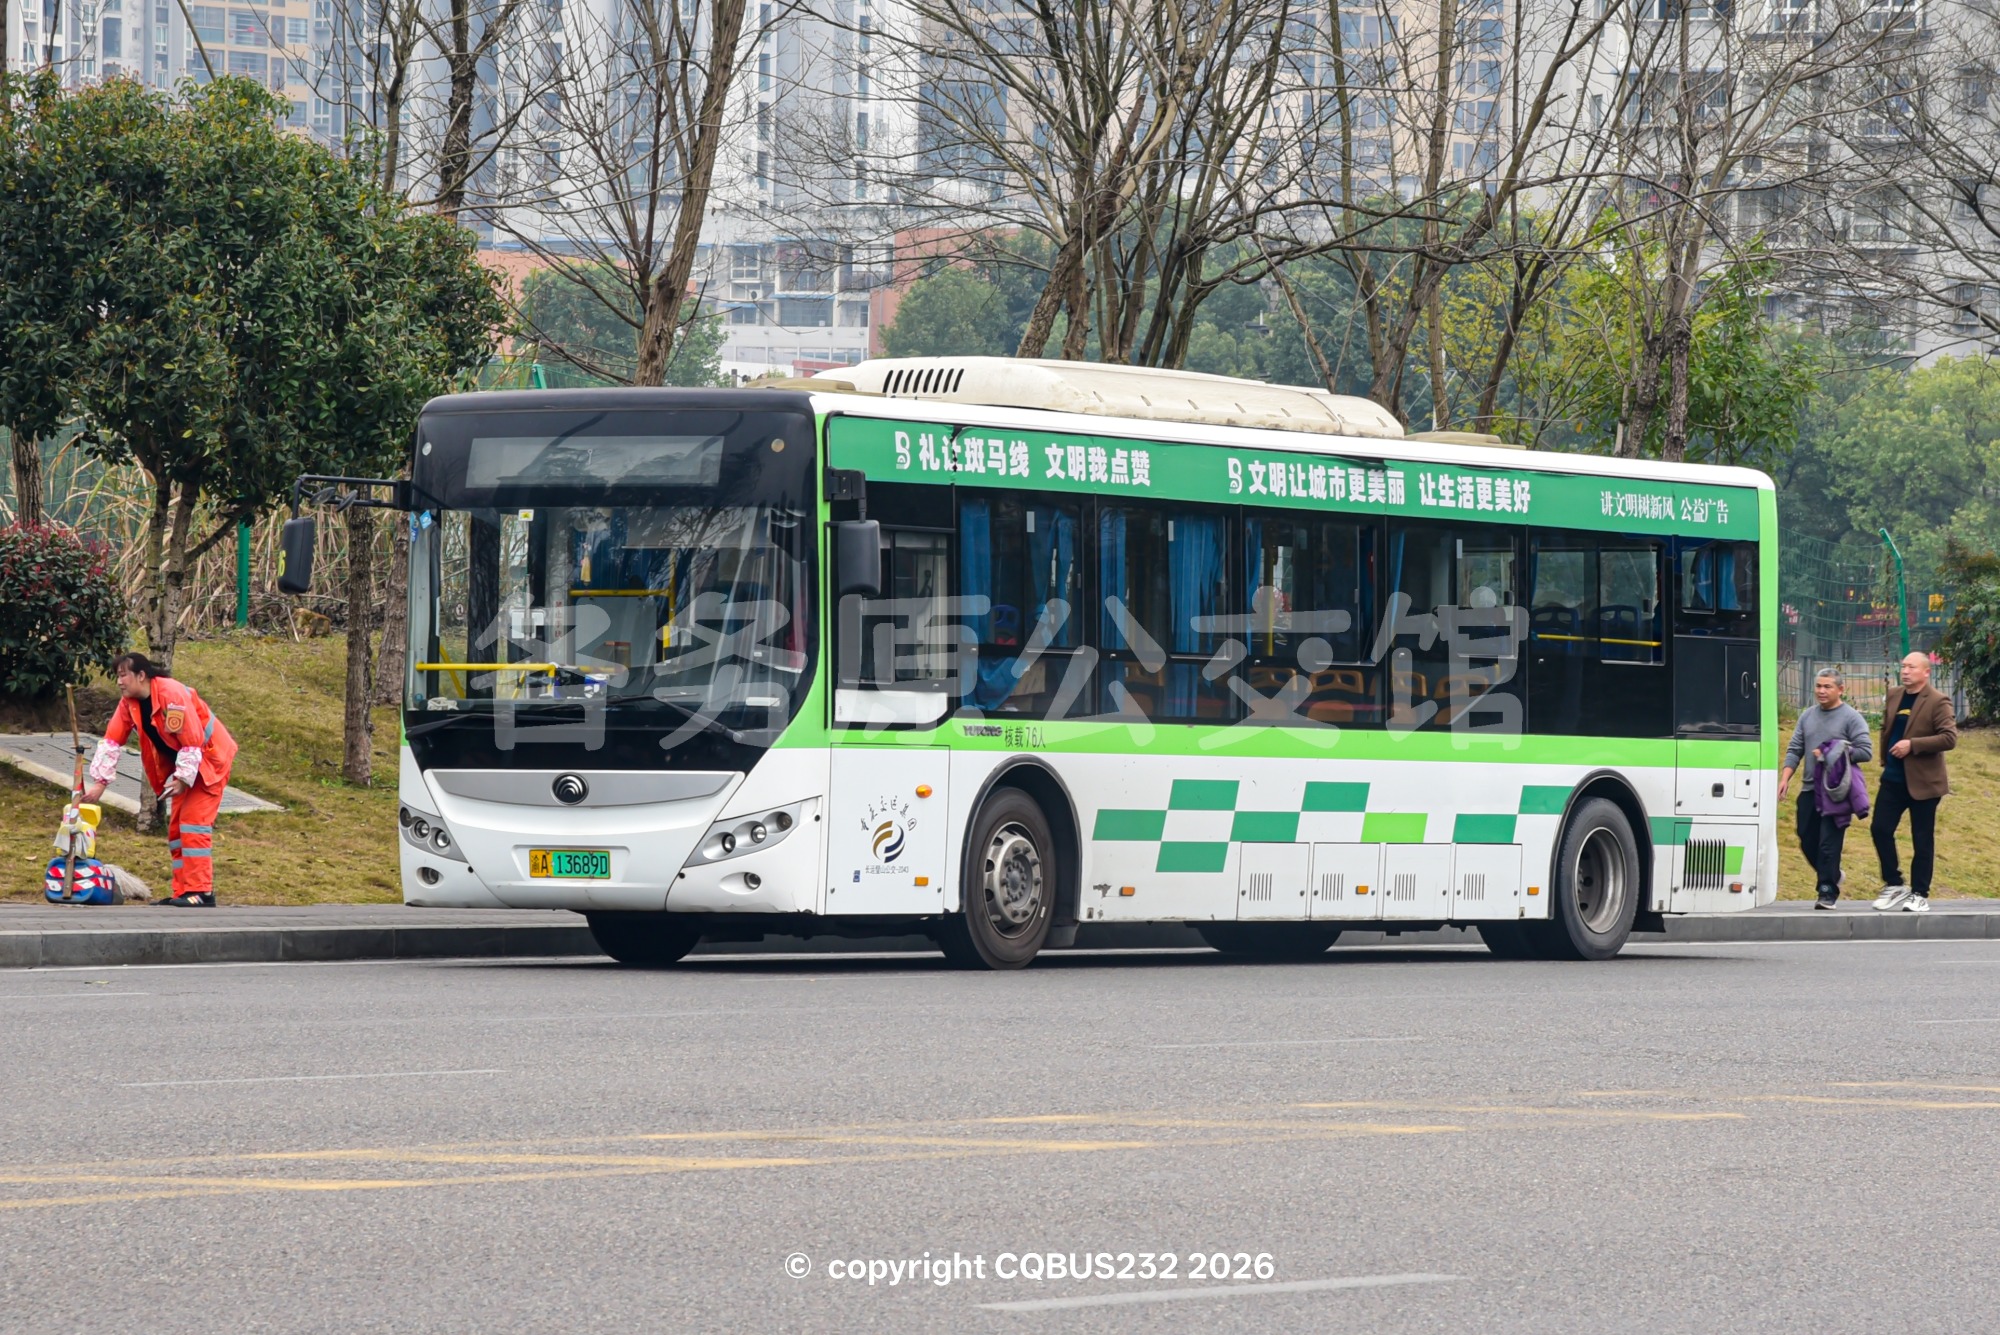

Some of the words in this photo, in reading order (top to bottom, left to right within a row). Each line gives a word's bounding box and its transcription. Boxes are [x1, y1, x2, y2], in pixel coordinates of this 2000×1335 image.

[919, 433, 1029, 478] 礼让斑马线
[1045, 443, 1151, 487] 文明我点赞
[1248, 460, 1405, 505] 文明让城市更美丽
[1419, 473, 1531, 514] 让生活更美好
[1601, 491, 1675, 520] 讲文明树新风
[1680, 497, 1729, 524] 公益广告
